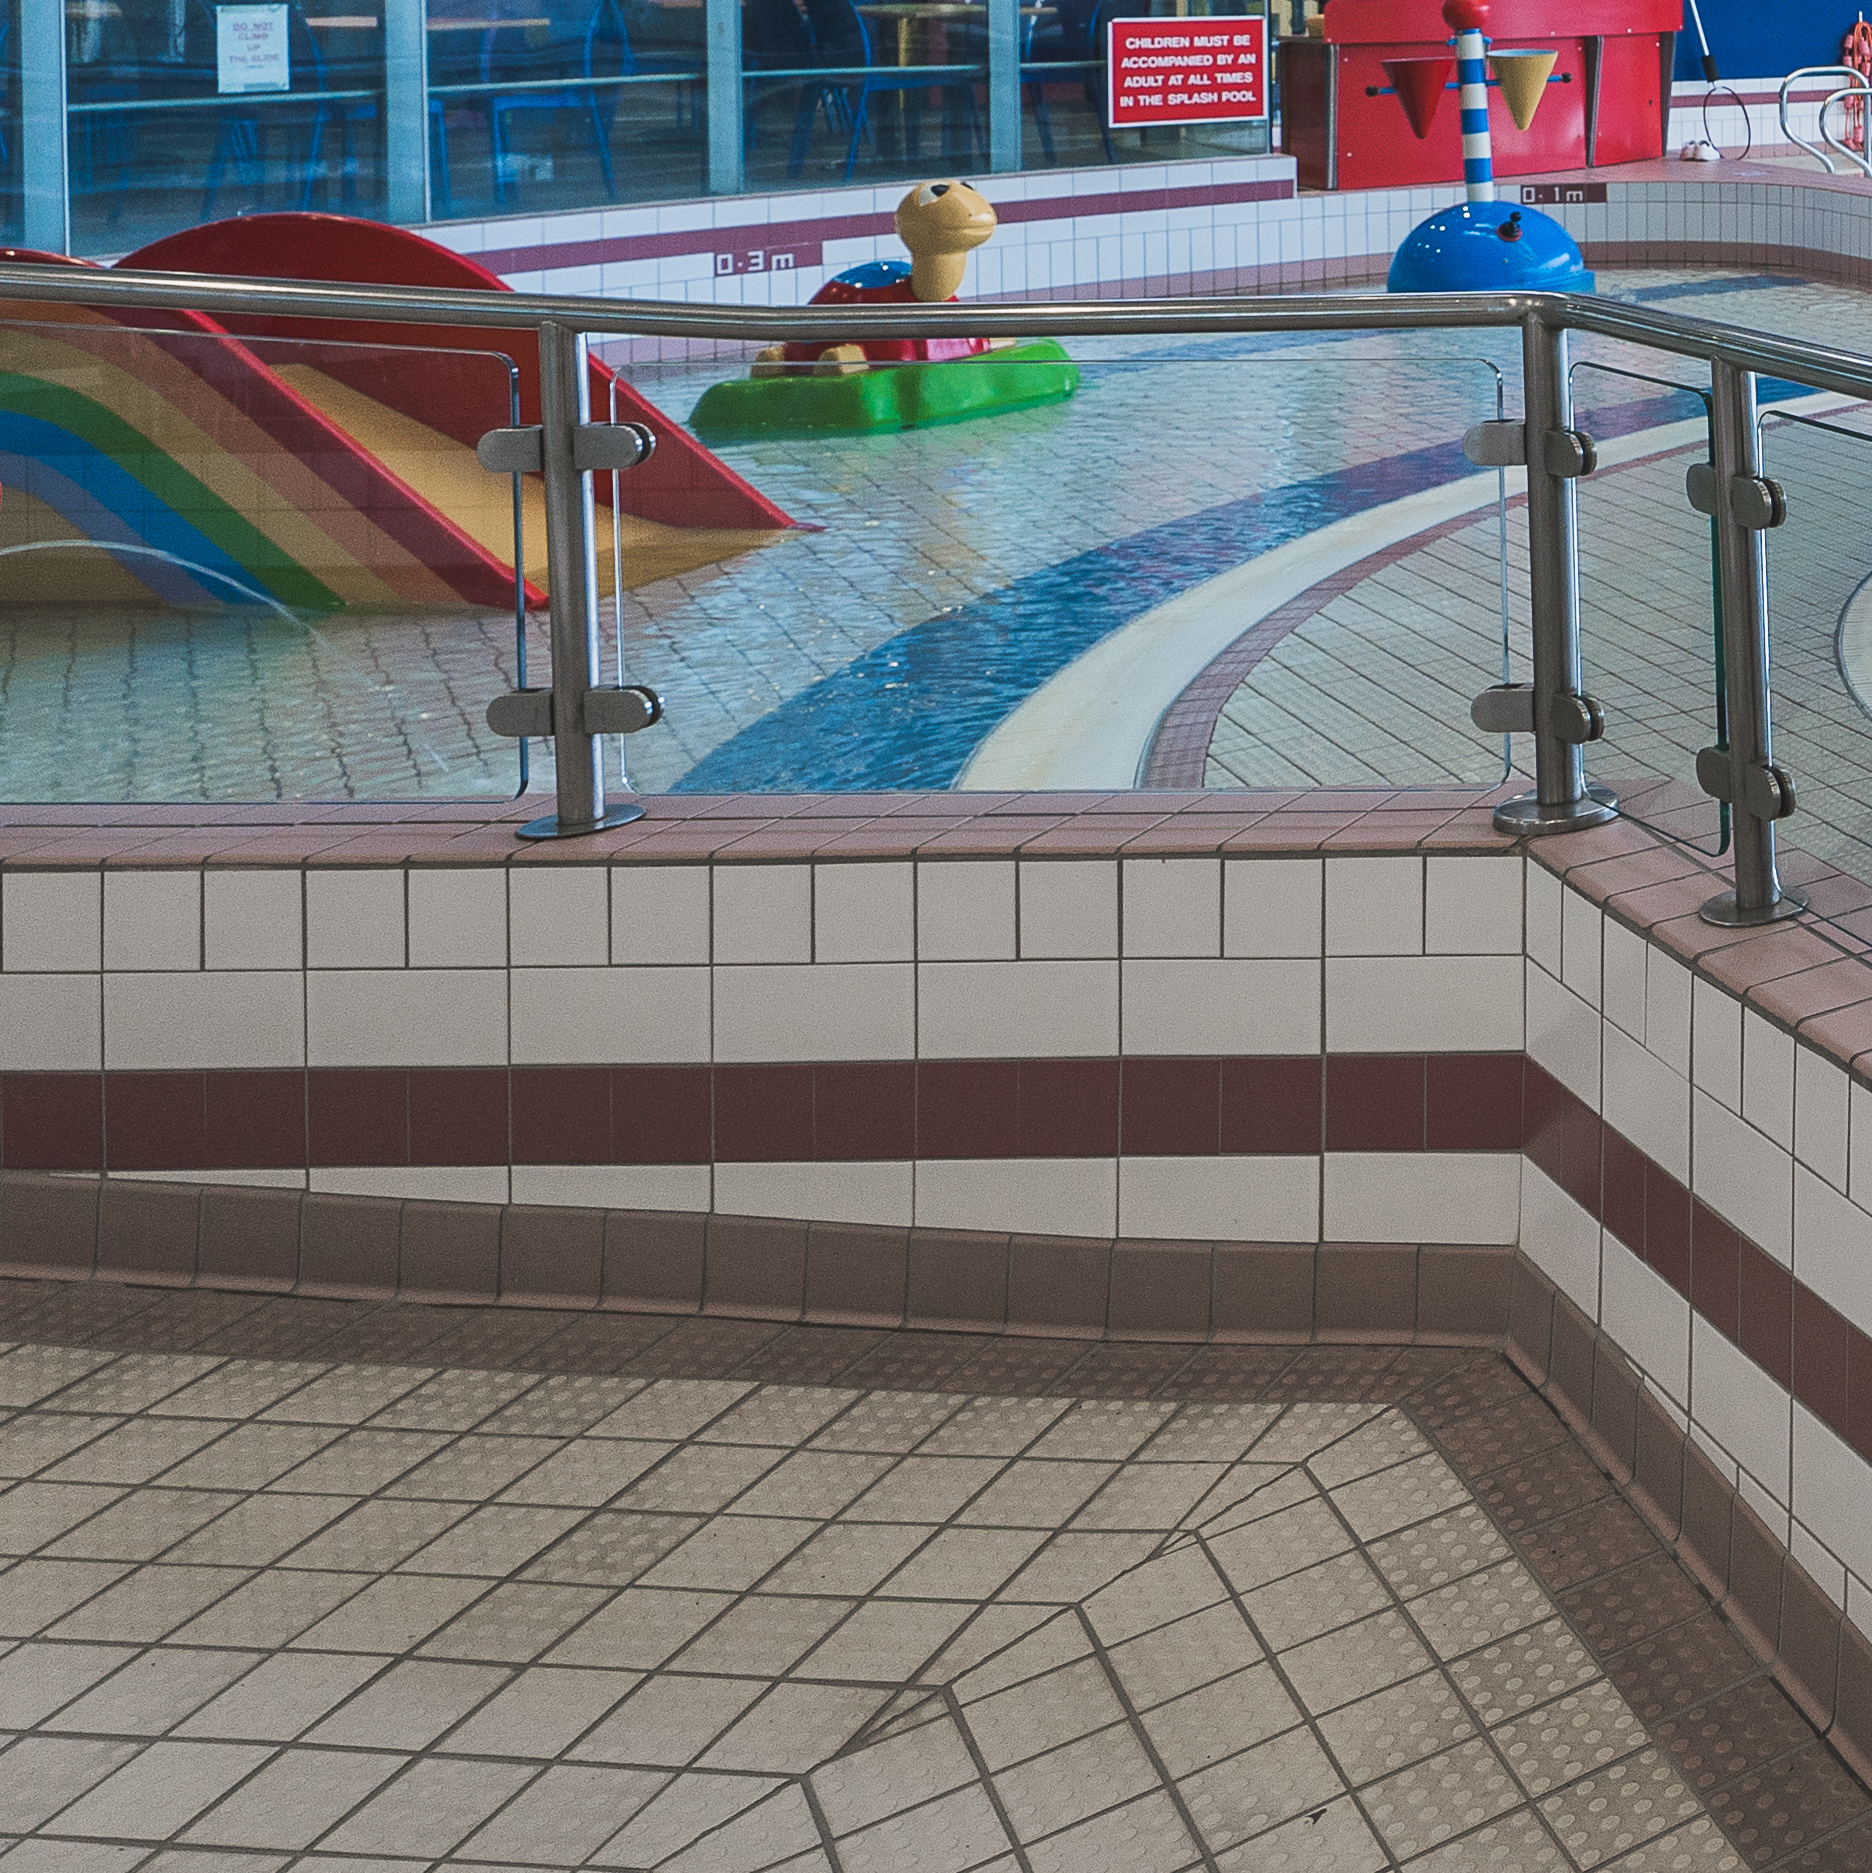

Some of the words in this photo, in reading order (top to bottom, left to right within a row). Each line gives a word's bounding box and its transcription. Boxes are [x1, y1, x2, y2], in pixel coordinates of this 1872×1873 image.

[1125, 36, 1190, 49] CHILDREN
[1194, 35, 1229, 46] MUST
[1233, 35, 1251, 46] BE
[1121, 54, 1213, 69] ACCOMPANIED
[1217, 54, 1234, 65] BY
[1237, 53, 1256, 64] AN
[1124, 74, 1165, 88] ADULT
[1168, 74, 1184, 86] AT
[1187, 73, 1211, 85] ALL
[1215, 72, 1253, 84] TIMES
[1119, 95, 1134, 107] IN
[1137, 94, 1163, 106] THE
[1167, 92, 1218, 105] SPLASH
[1221, 91, 1256, 102] POOL
